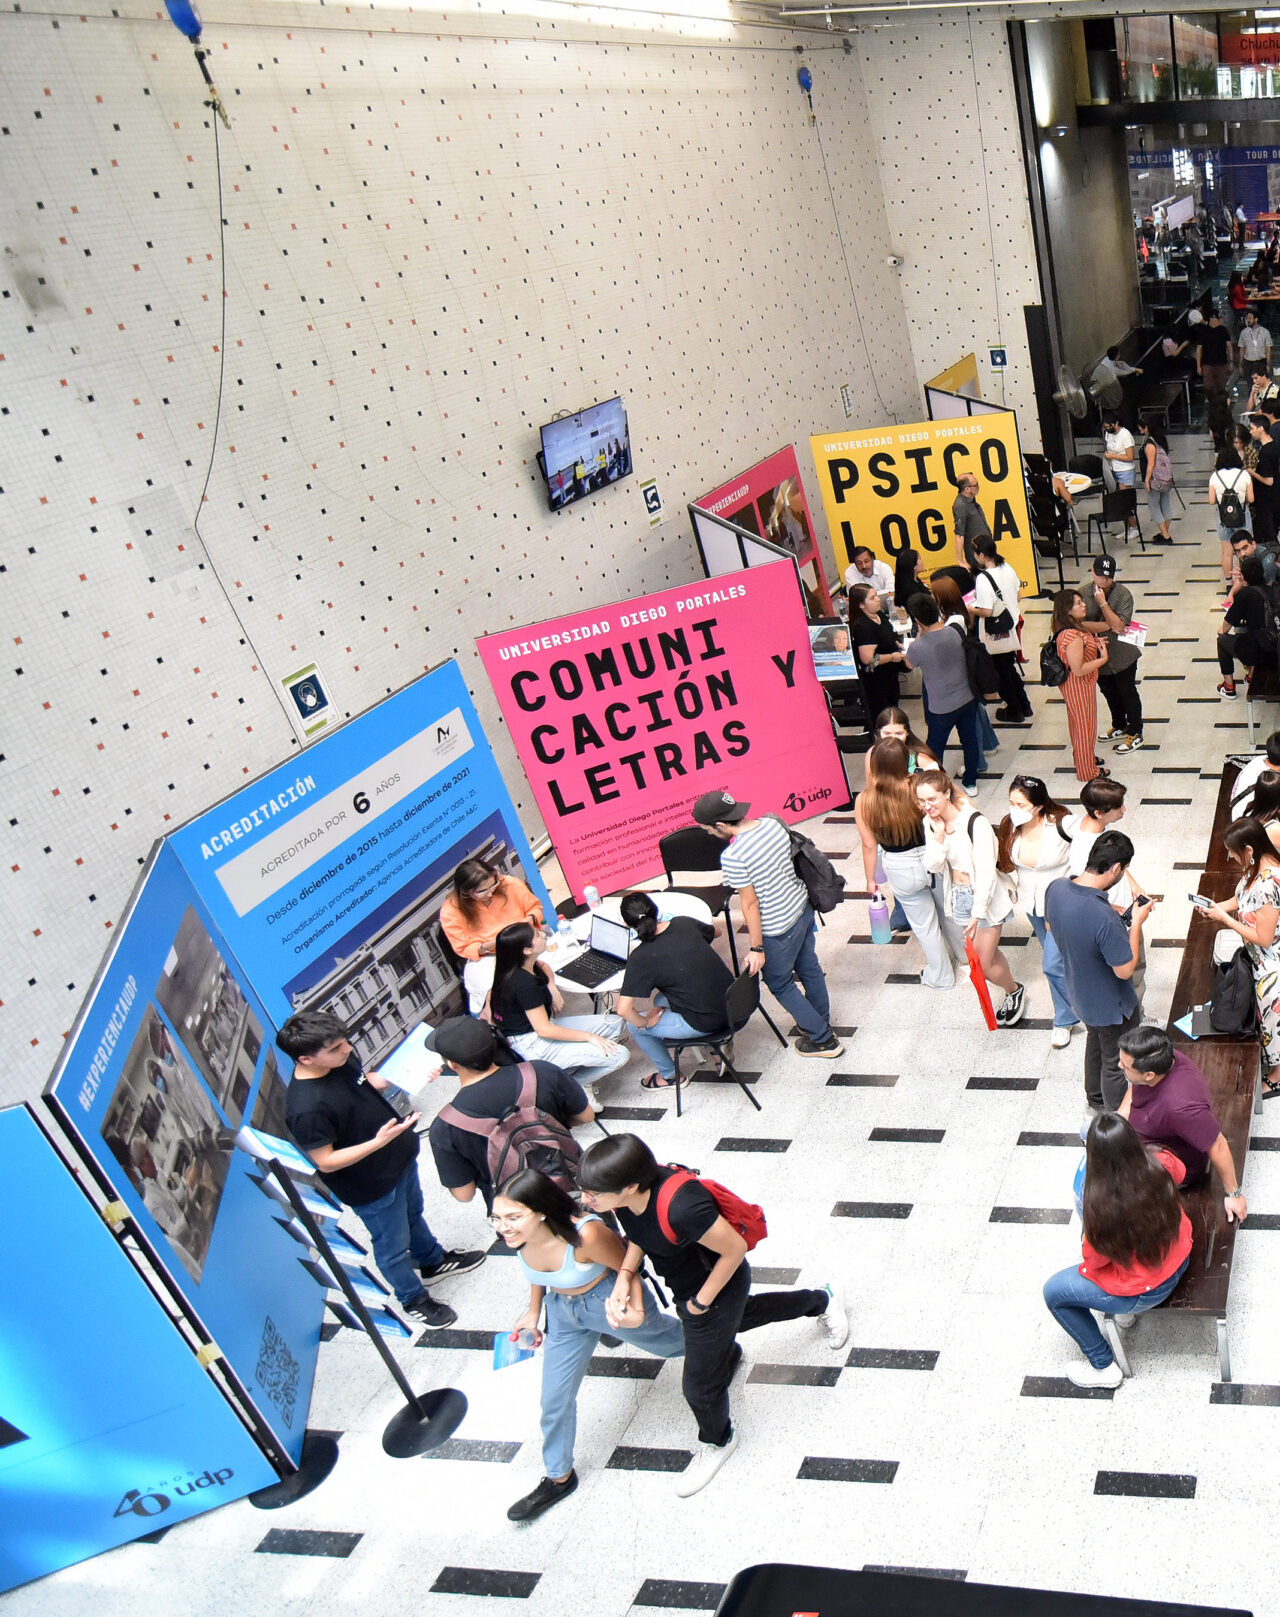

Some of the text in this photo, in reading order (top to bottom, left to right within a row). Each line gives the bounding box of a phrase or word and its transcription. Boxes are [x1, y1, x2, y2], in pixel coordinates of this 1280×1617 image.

[1246, 150, 1268, 160] TOUR
[824, 425, 983, 453] UNIVERSIDAD DIEGO PORTALES
[827, 438, 1009, 504] PSICO
[840, 498, 1021, 564] LOGA
[499, 584, 748, 661] UNIVERSIDAD DIEGO PORTALES
[511, 618, 726, 712] COMUNI
[530, 669, 738, 765] CACIÓN
[771, 650, 796, 689] Y
[547, 720, 751, 818] LETRAS
[808, 788, 832, 802] udp
[200, 774, 317, 861] ACREDITACIÓN
[260, 773, 401, 878] ACREDITADA POR 6 AÑOS
[266, 767, 471, 925] Desde diciembre de 2015 hasta diciembre de 2021
[569, 836, 580, 845] La
[580, 820, 628, 841] Universidad
[628, 811, 651, 826] Diego
[652, 801, 685, 816] Portales
[685, 793, 706, 804] entre
[573, 838, 614, 855] formación
[615, 821, 657, 842] profesional
[664, 808, 695, 823] intelect
[577, 851, 606, 866] calidad
[607, 846, 617, 855] en
[618, 829, 670, 852] humanidades
[675, 819, 697, 832] cienc
[281, 904, 329, 946] Acreditación
[387, 831, 422, 860] Resolución
[580, 858, 620, 876] contribuir
[620, 853, 635, 863] con
[294, 919, 336, 955] Organismo
[335, 885, 378, 922] Acreditador:
[78, 974, 138, 1113] #EXPERIENCIAUDP
[174, 1468, 234, 1496] udp
